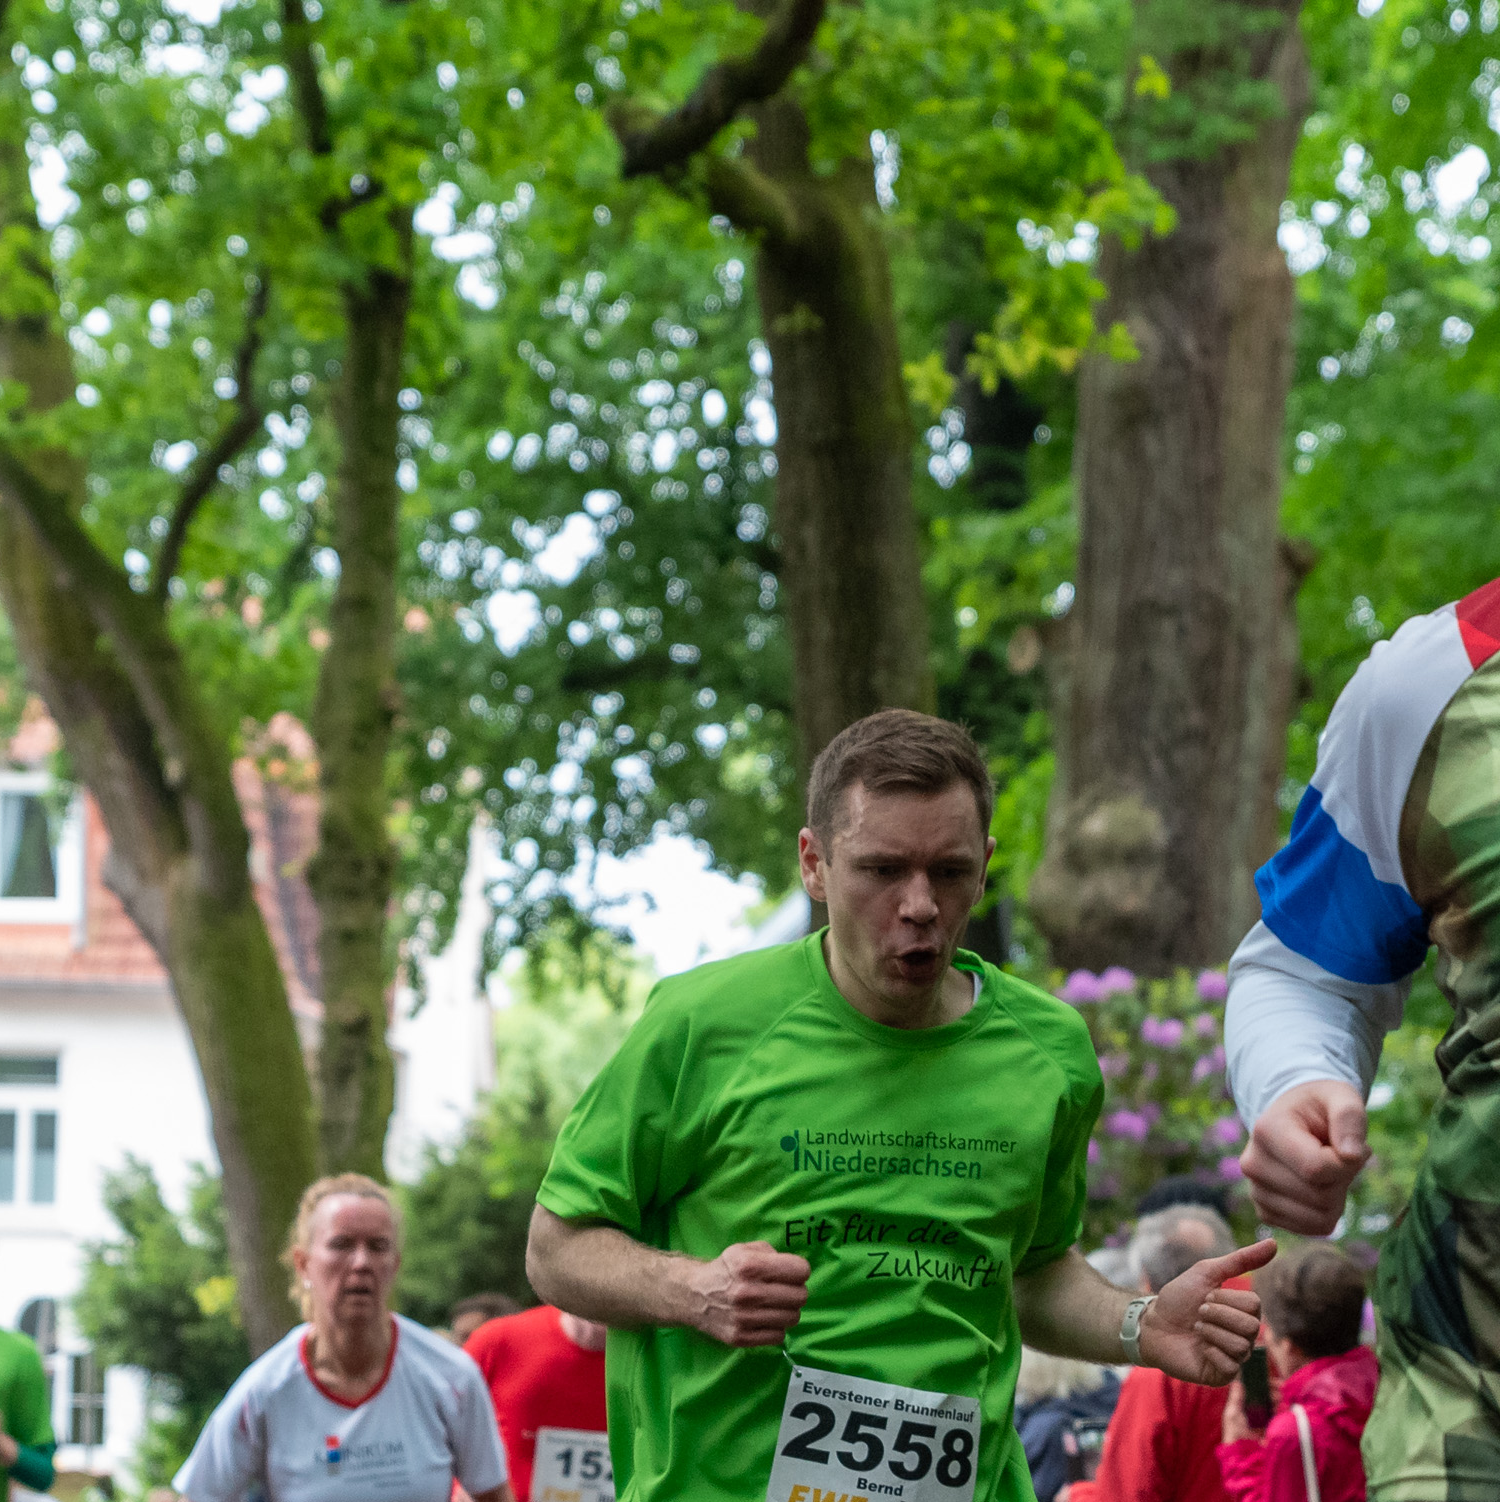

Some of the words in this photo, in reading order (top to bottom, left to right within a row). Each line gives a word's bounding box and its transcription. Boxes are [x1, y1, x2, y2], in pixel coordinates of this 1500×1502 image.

[806, 1128, 1017, 1153] Landwirtschaftskammer
[803, 1149, 982, 1180] Niedersachsen
[785, 1216, 833, 1247] Fit
[841, 1213, 897, 1244] für
[907, 1219, 960, 1246] die
[865, 1250, 1003, 1288] Zukunft!
[802, 1381, 890, 1409] Everstener
[893, 1398, 975, 1424] Brunnenlauf
[780, 1401, 975, 1489] 2558
[555, 1447, 614, 1482] 15
[856, 1477, 904, 1497] Bernd
